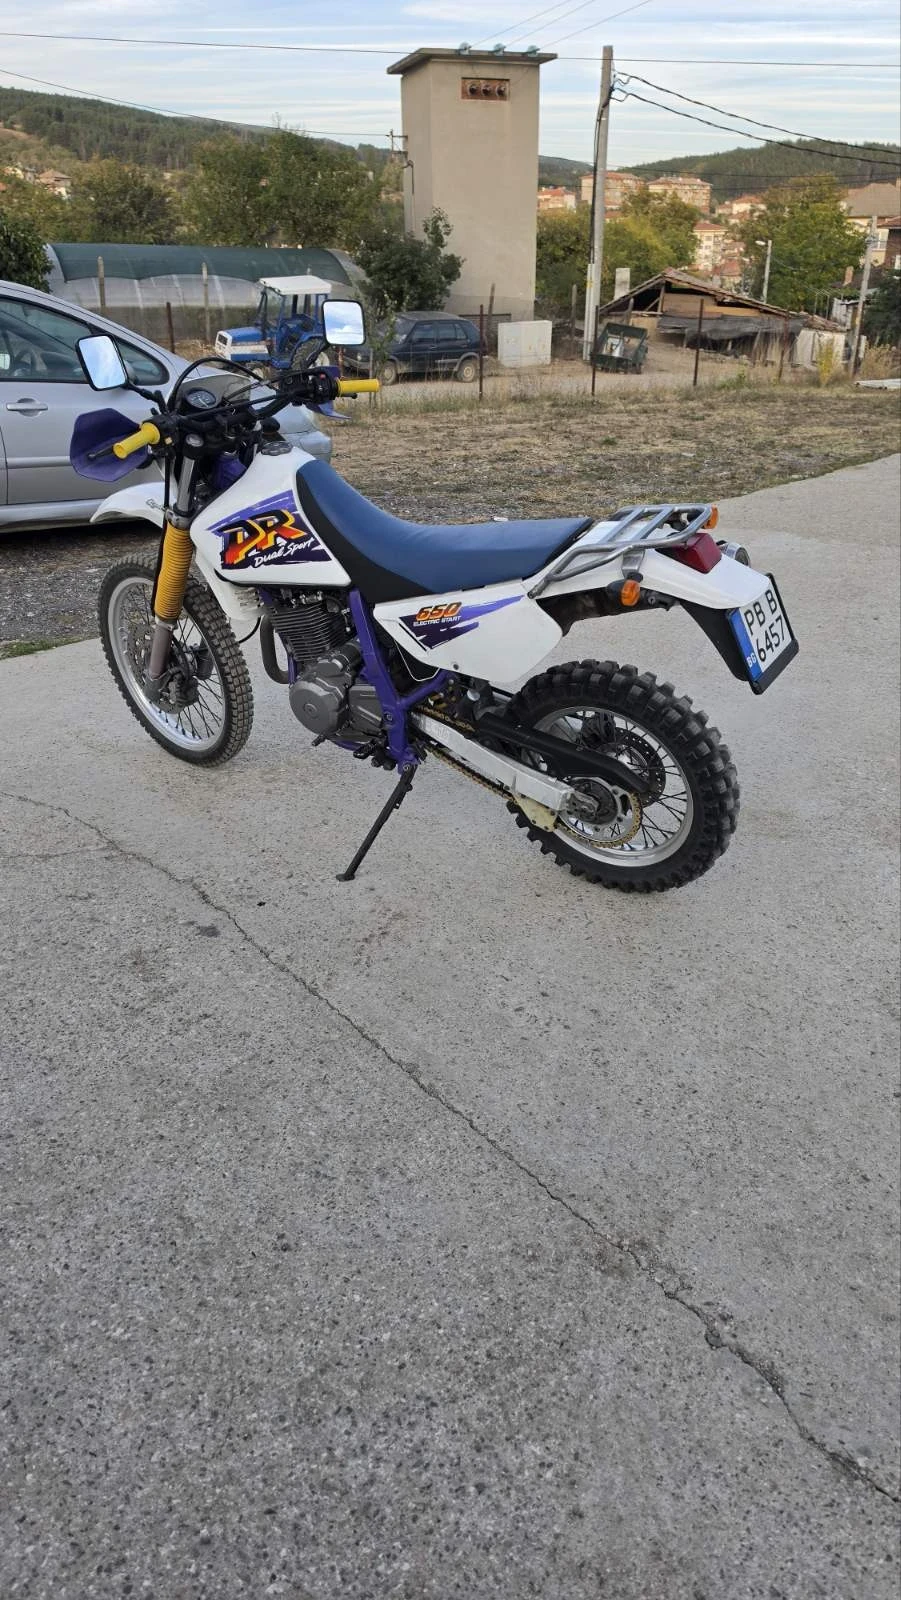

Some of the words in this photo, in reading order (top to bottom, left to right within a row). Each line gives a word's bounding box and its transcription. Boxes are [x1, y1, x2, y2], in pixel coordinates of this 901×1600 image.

[218, 508, 307, 565] DR
[254, 546, 285, 567] Dual
[283, 537, 315, 556] Sport
[415, 602, 462, 621] 650
[744, 602, 766, 635] PB
[765, 589, 777, 615] B
[756, 614, 785, 662] 6457
[746, 652, 757, 668] BG
